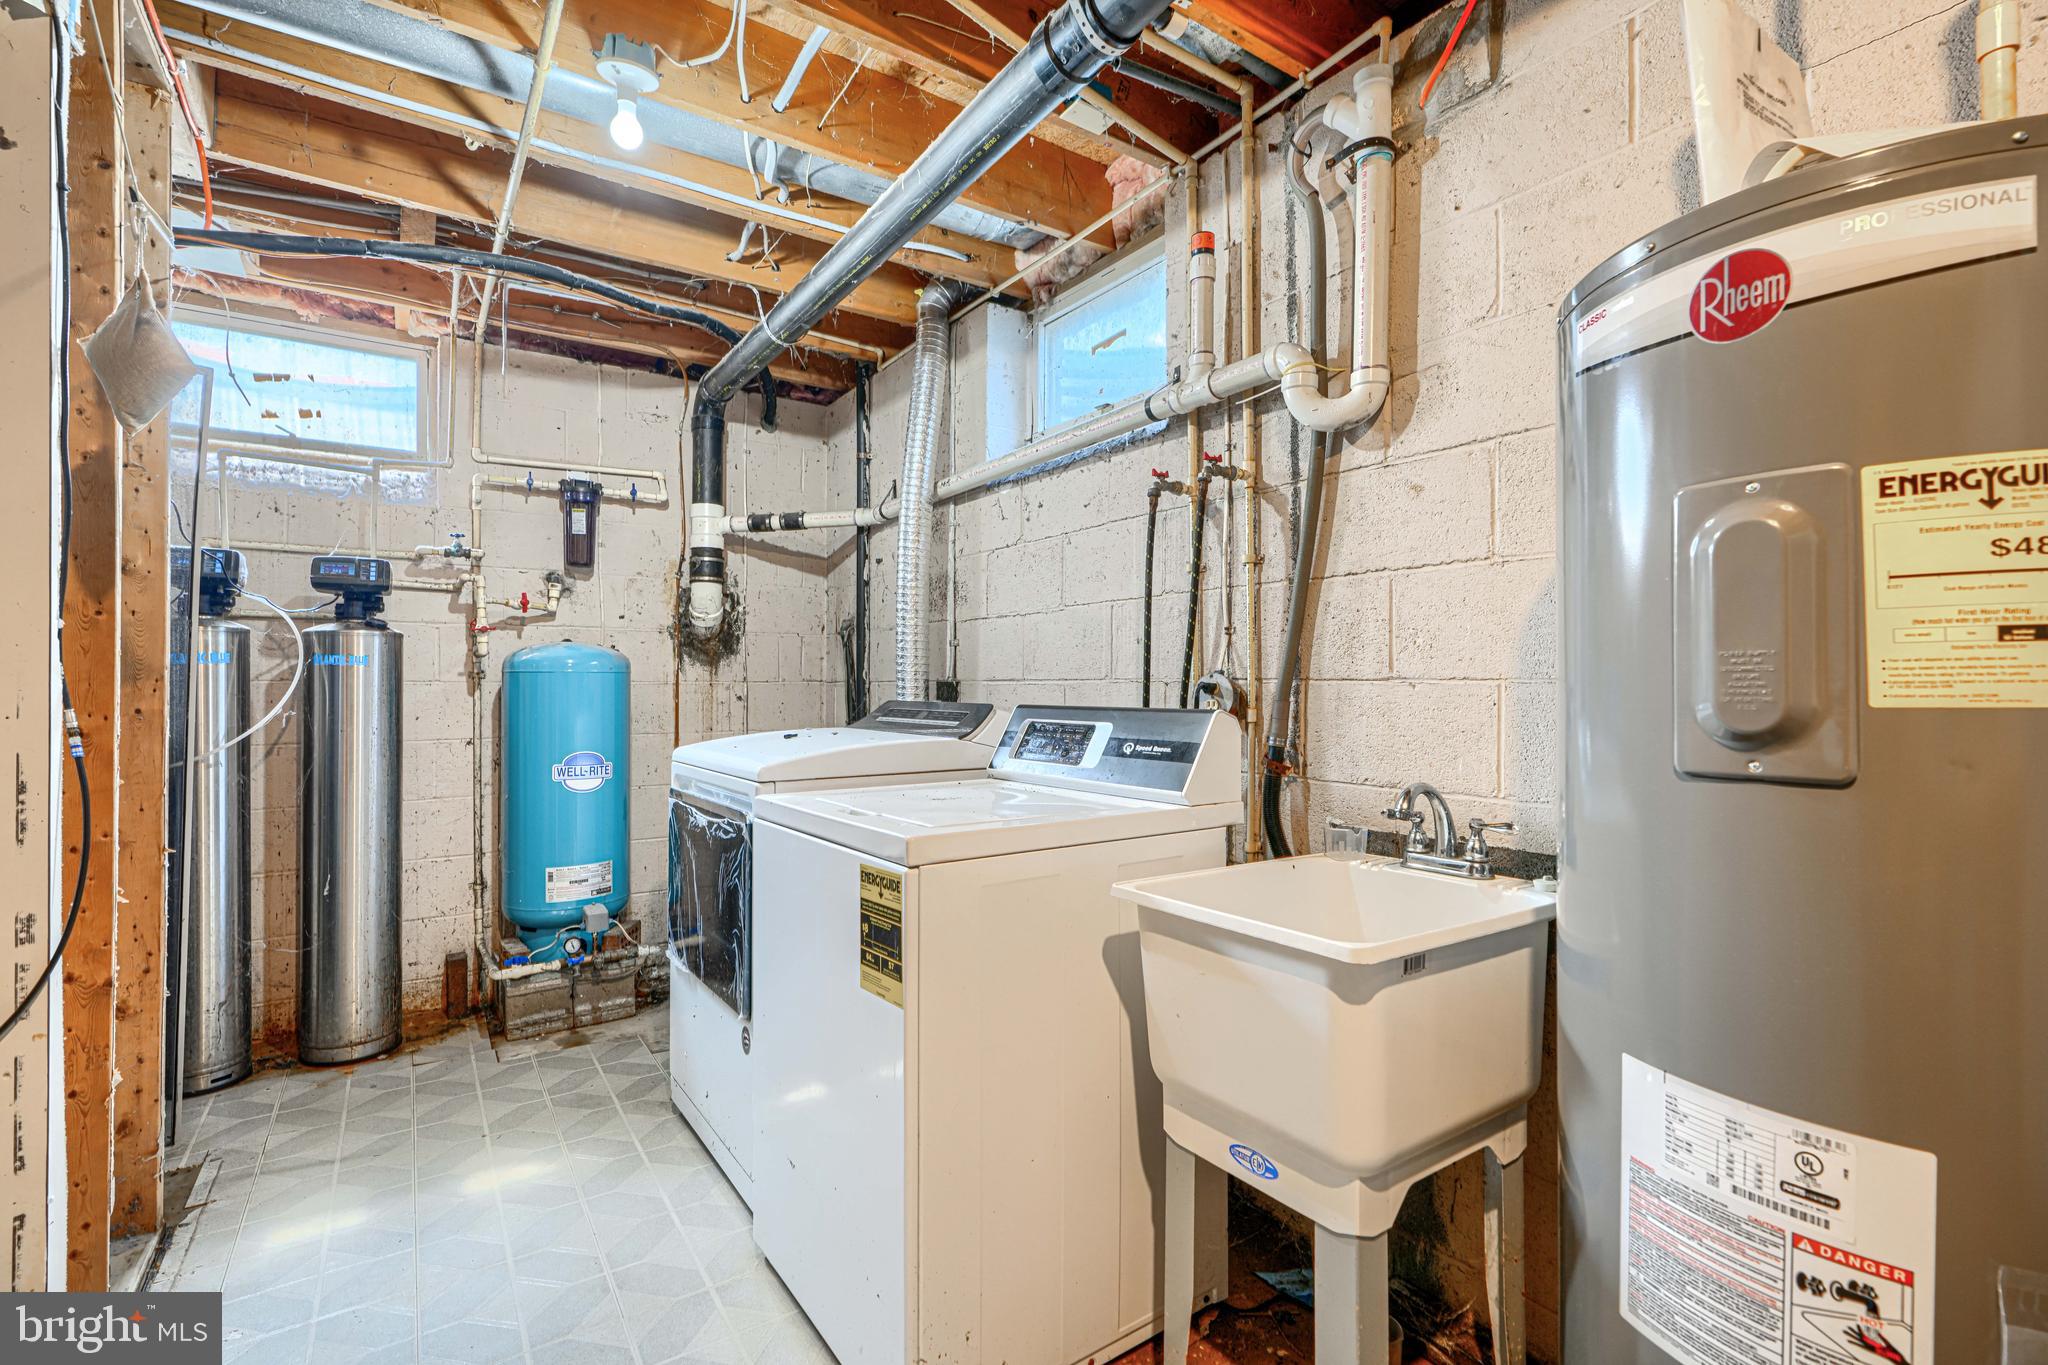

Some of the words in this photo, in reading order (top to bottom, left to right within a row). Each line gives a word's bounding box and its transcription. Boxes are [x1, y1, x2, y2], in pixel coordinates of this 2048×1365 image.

[1699, 257, 1786, 333] Rheem
[1578, 309, 1607, 334] CLASSIC
[1135, 744, 1153, 752] Speed
[861, 870, 901, 894] ENERGYGUIDE
[1801, 1155, 1817, 1173] UL
[1820, 1245, 1907, 1283] DANGER
